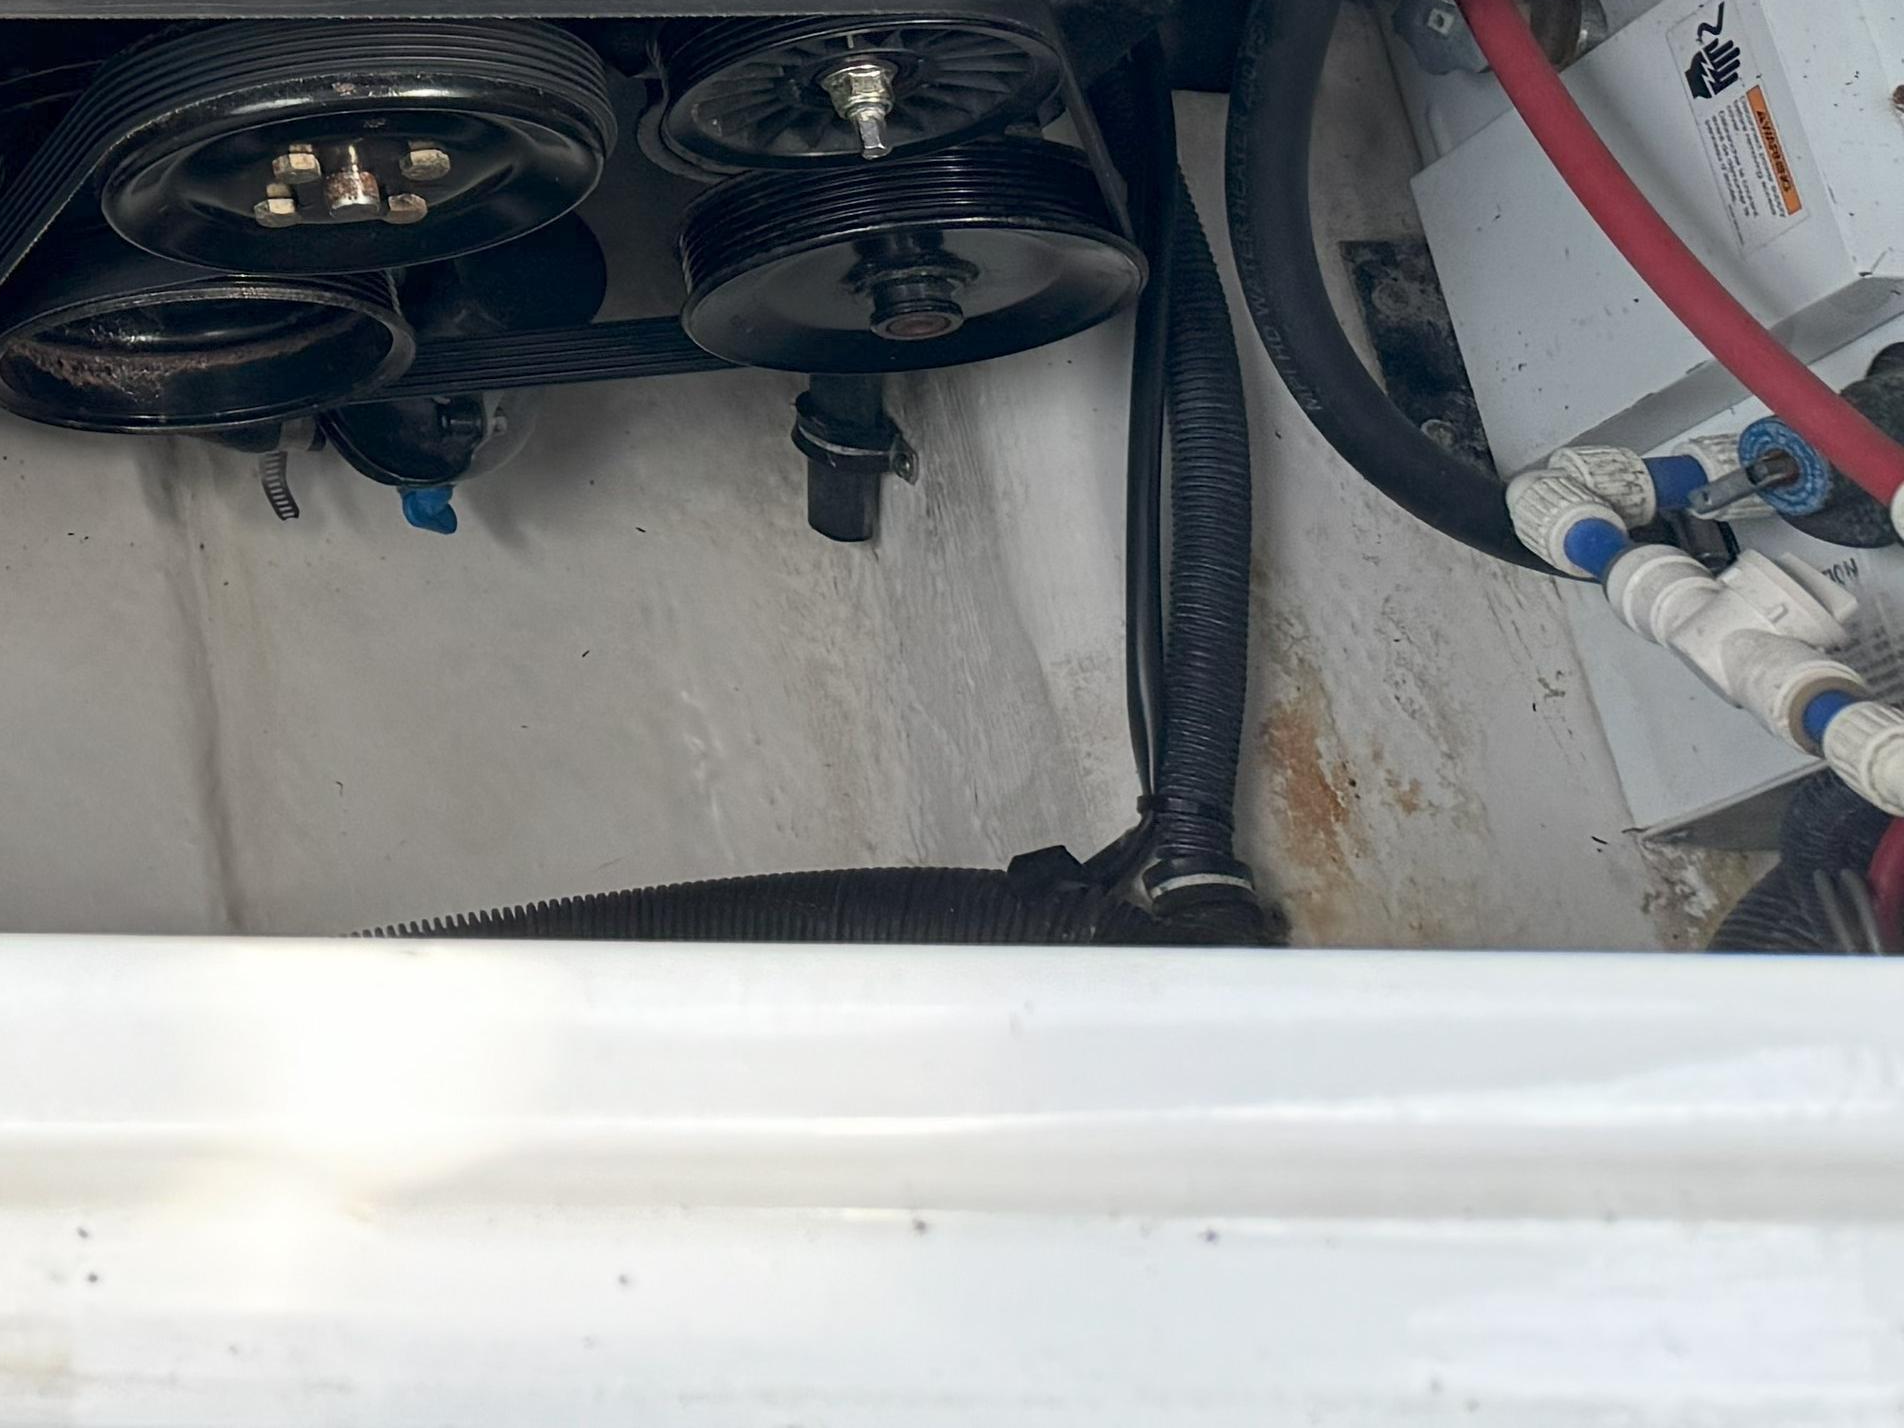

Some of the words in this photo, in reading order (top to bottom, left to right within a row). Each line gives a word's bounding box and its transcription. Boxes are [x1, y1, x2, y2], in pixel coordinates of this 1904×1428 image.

[1234, 112, 1253, 231] HEATER
[1761, 118, 1793, 195] WARNING
[1239, 231, 1271, 317] WATER
